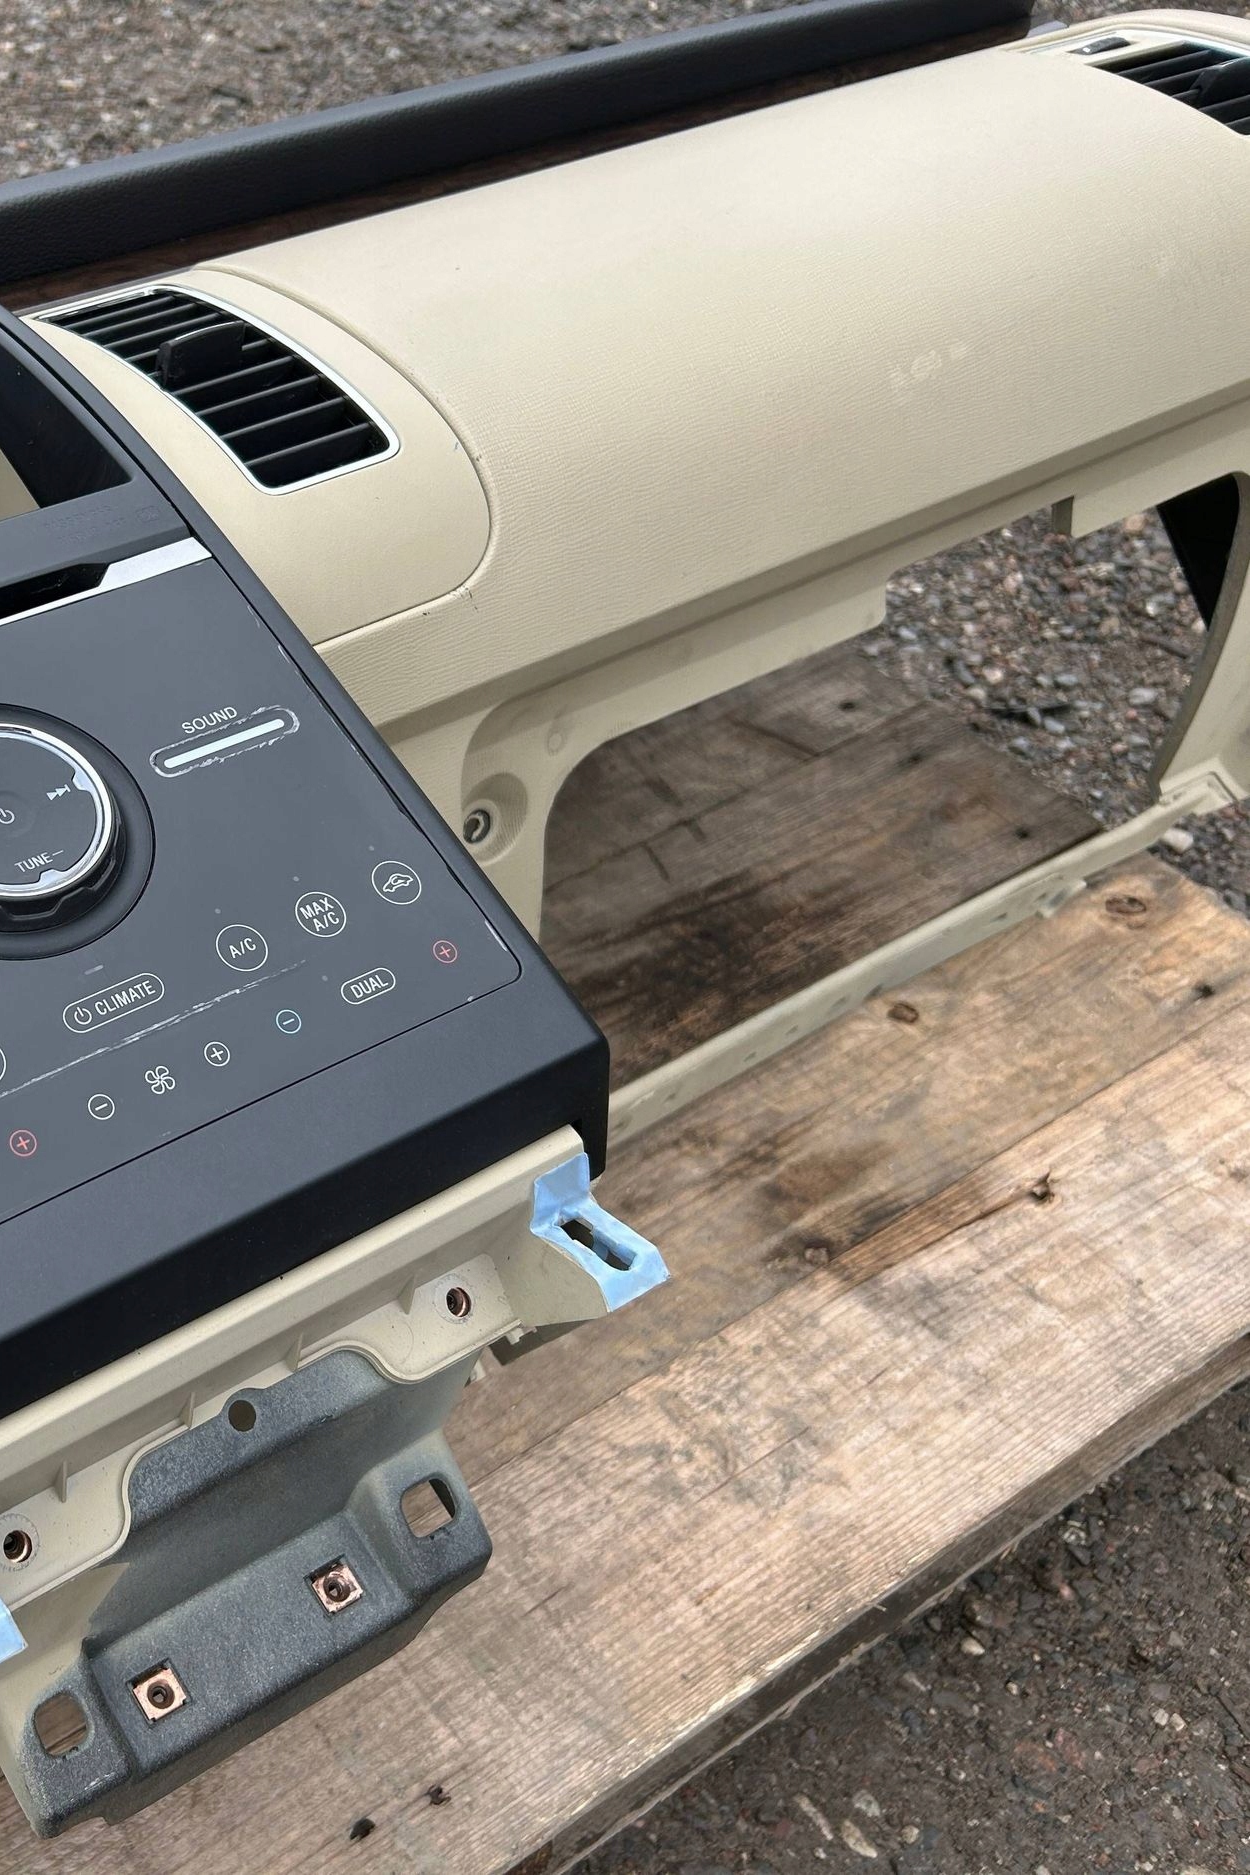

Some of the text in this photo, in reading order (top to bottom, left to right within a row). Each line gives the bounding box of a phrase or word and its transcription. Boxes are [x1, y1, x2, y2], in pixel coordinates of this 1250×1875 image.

[181, 705, 237, 734] SOUND
[300, 898, 335, 920] MAX
[313, 911, 341, 933] A/C
[229, 937, 257, 959] A/C
[94, 980, 156, 1017] CLIMATE
[350, 973, 389, 1000] DUAL
